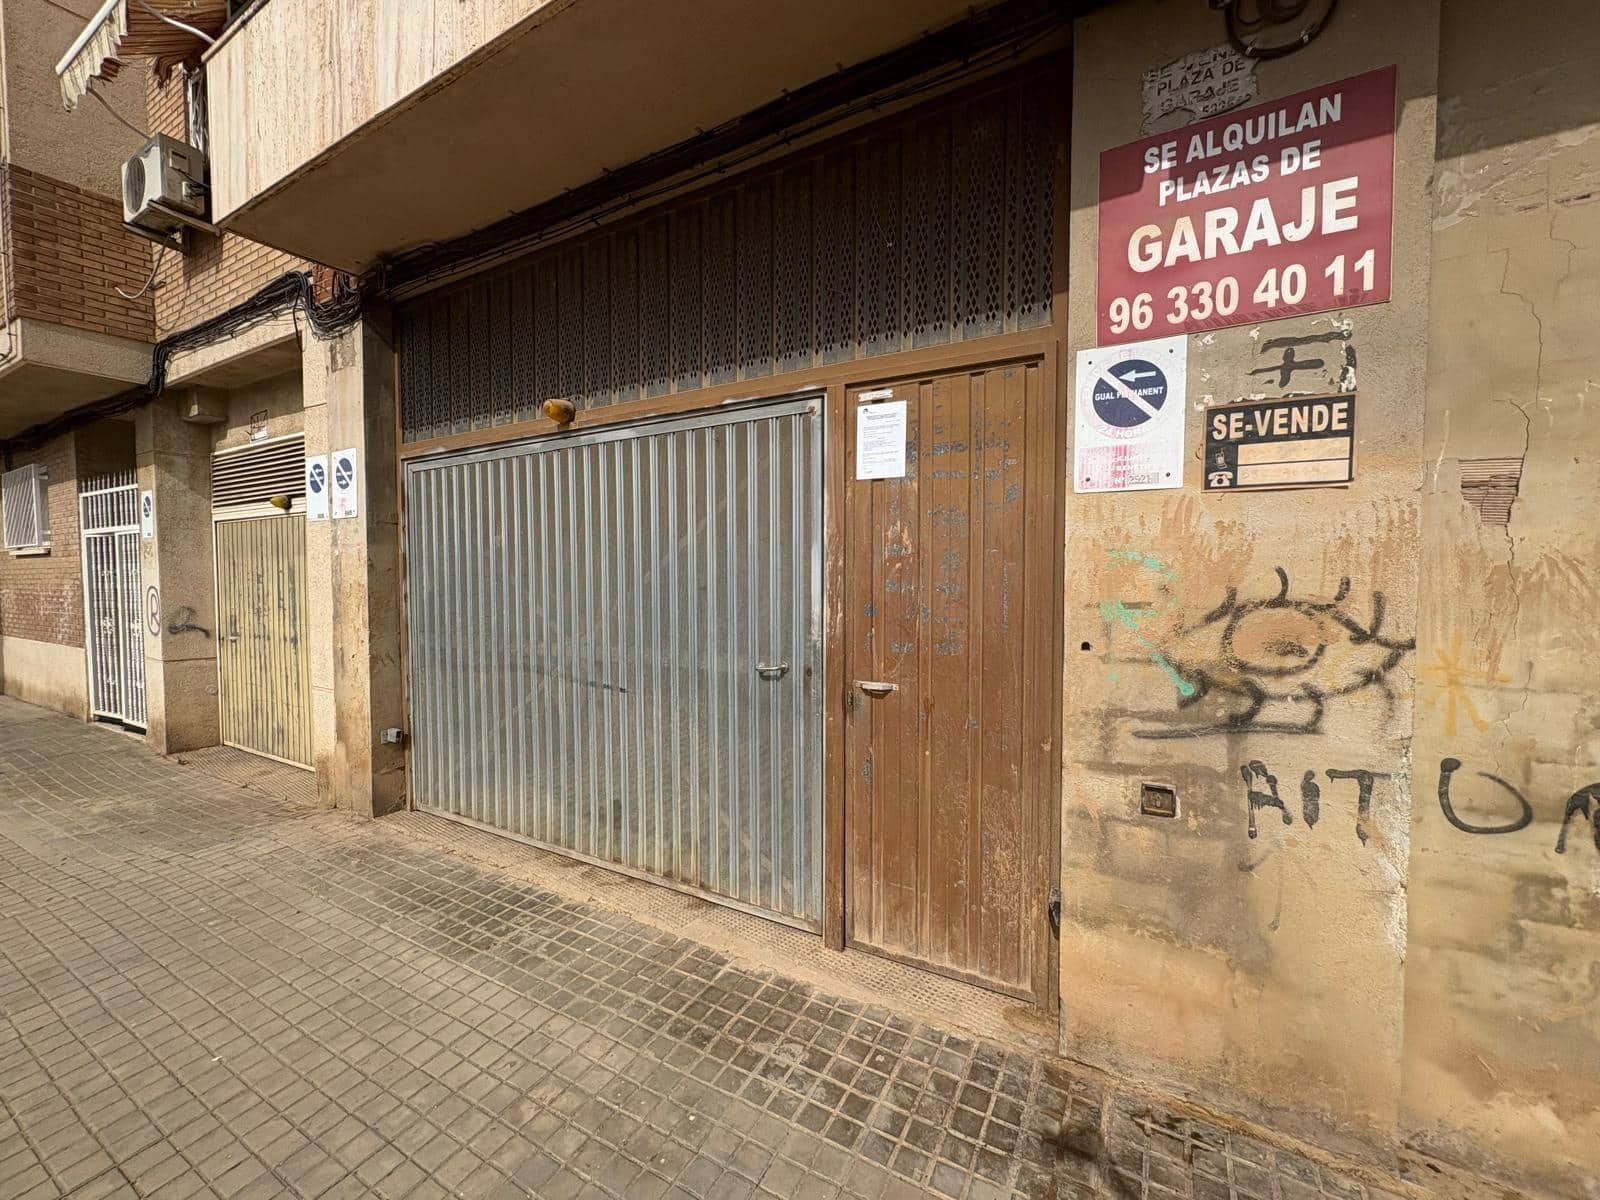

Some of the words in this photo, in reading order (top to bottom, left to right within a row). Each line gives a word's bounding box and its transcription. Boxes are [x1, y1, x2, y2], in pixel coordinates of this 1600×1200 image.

[1157, 67, 1214, 96] PLAZA
[1222, 59, 1246, 76] DE
[1161, 78, 1240, 111] GARAJE
[1144, 140, 1177, 174] SE
[1185, 93, 1342, 164] ALQUILAN
[1159, 154, 1270, 207] PLAZAS
[1280, 139, 1322, 176] DE
[1127, 176, 1359, 273] GARAJE
[1109, 292, 1153, 334] 96
[1166, 276, 1240, 324] 330
[1253, 263, 1307, 308] 40
[1324, 248, 1375, 296] 11
[1094, 392, 1115, 401] GUAL
[1116, 386, 1164, 399] PEMANENT
[1212, 402, 1348, 441] SE-VENDE
